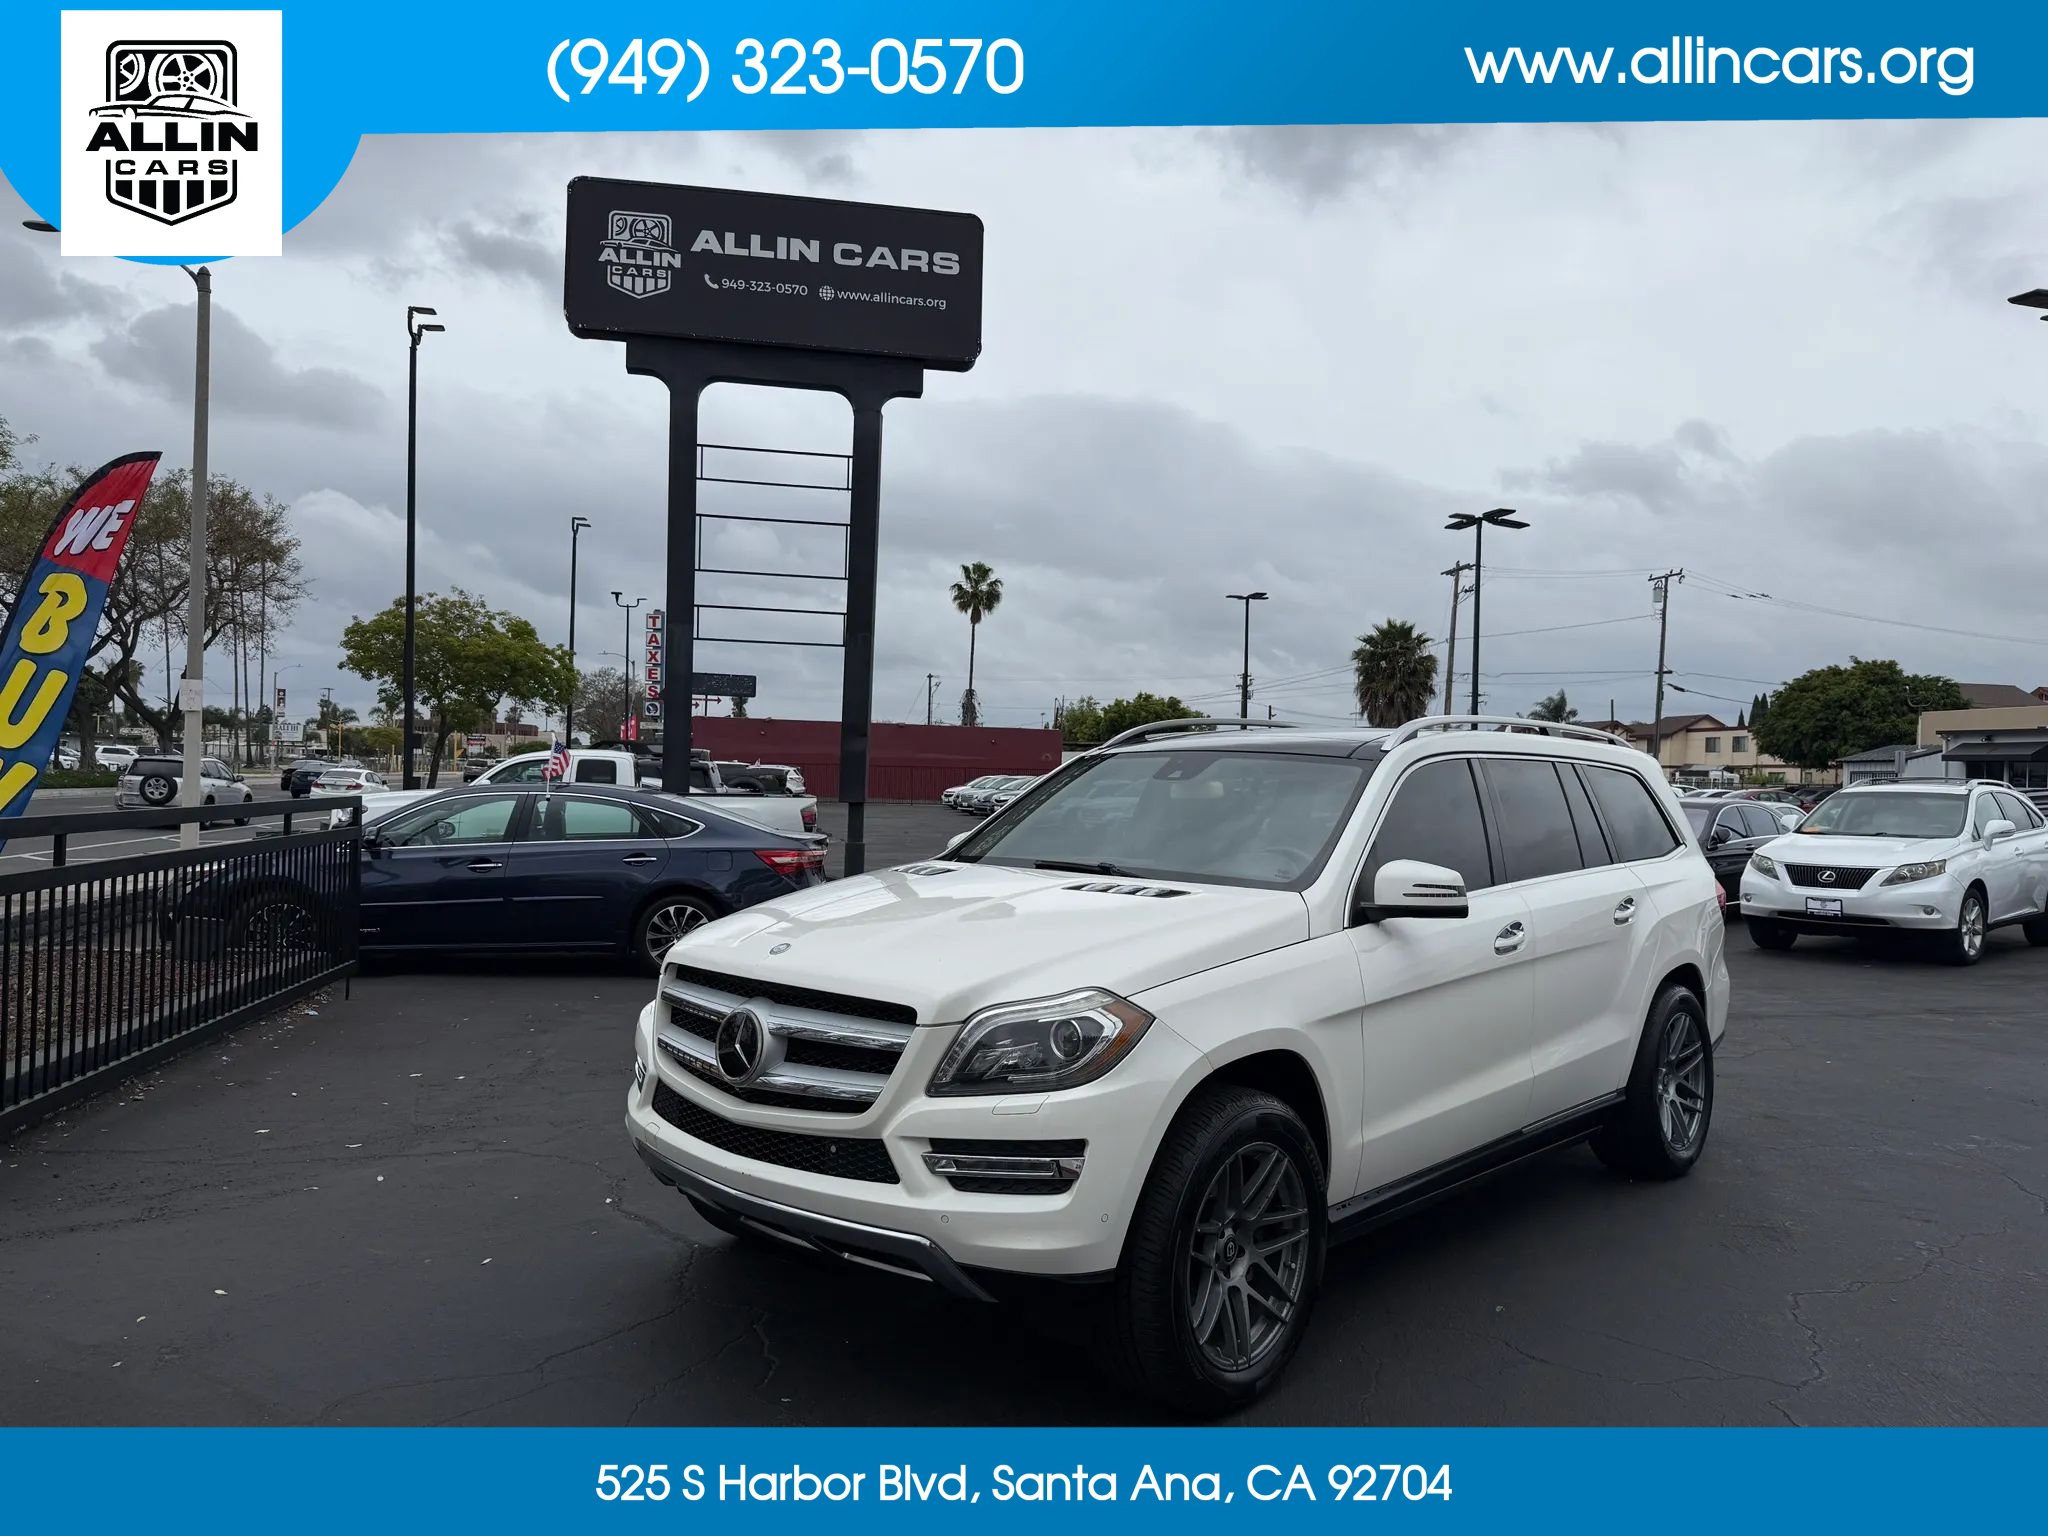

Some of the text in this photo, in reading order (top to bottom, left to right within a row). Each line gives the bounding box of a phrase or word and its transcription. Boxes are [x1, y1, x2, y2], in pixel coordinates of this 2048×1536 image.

[598, 248, 682, 268] ALLIN
[612, 266, 667, 278] CARS
[690, 230, 961, 276] ALLIN CARS
[721, 277, 947, 310] 949-323-0570 www.allincars.org
[54, 499, 136, 556] WE
[647, 615, 660, 700] TAXES
